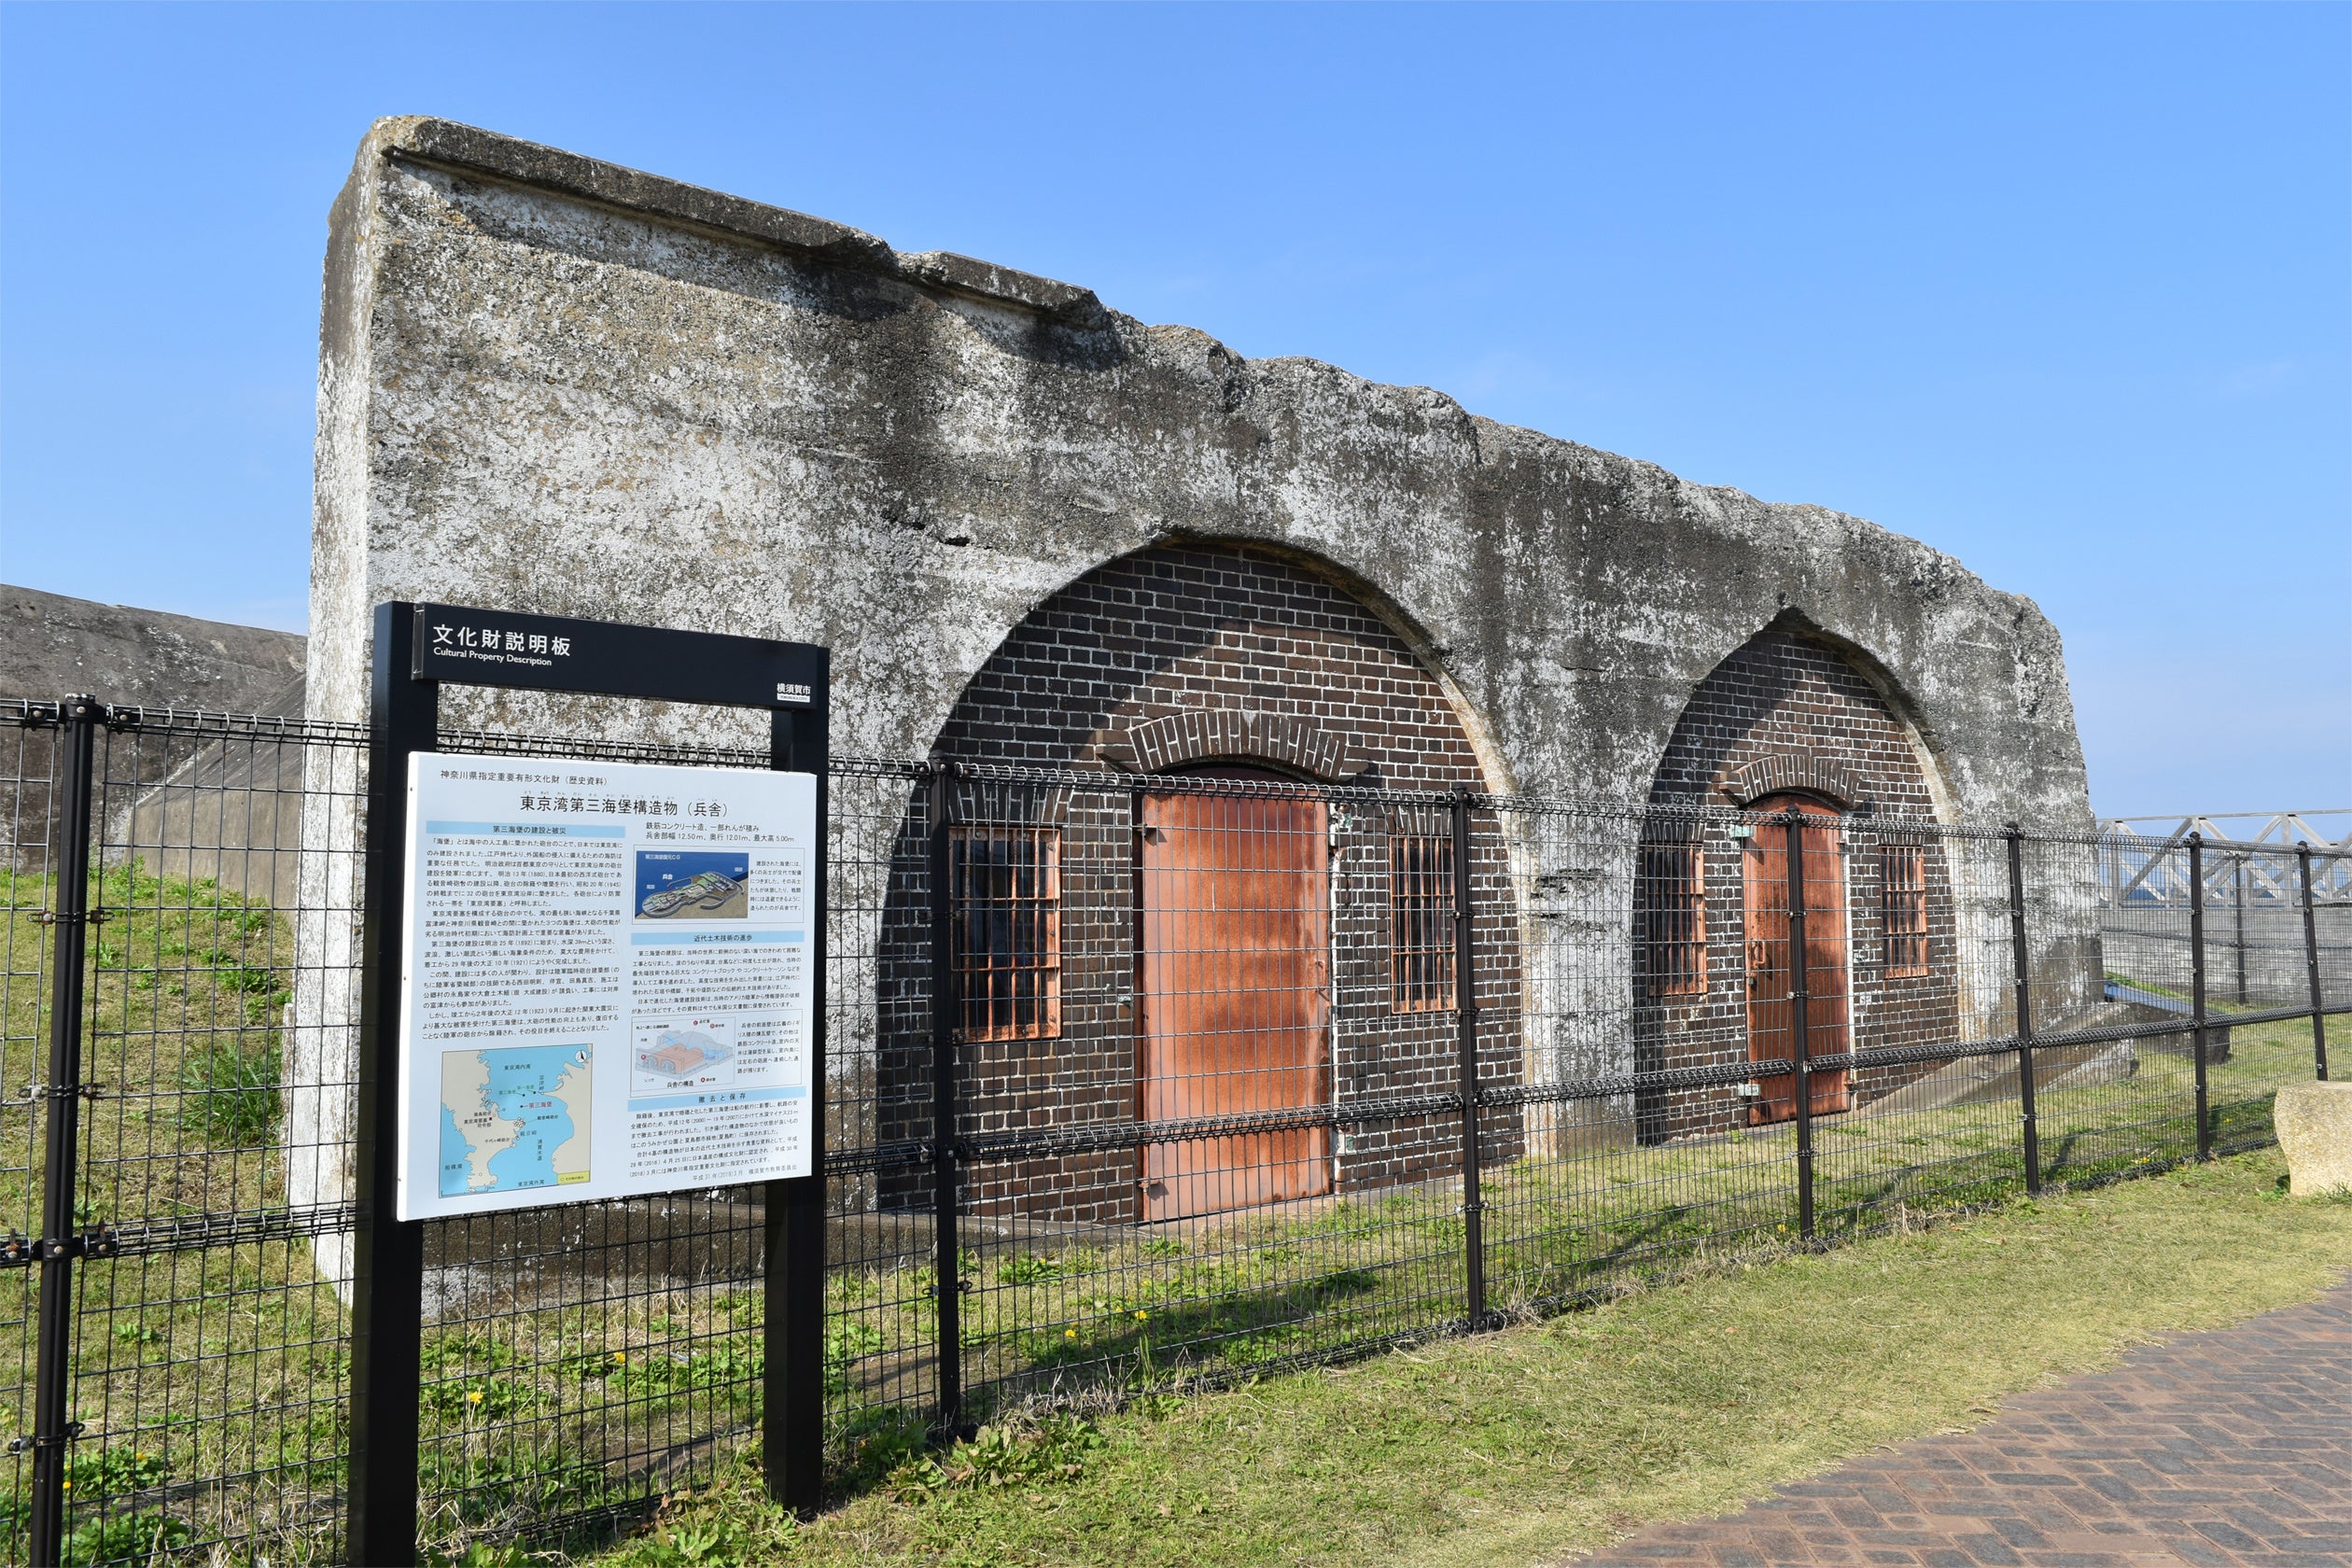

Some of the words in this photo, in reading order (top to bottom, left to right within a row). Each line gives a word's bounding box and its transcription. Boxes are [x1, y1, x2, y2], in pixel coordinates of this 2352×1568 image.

[432, 624, 571, 656] 文化財説明板
[433, 647, 468, 659] Cultural
[469, 651, 504, 664] Property
[507, 653, 552, 666] Description
[777, 683, 811, 695] 横須賀市
[493, 825, 567, 835] 第三海堡の建設と被災
[693, 934, 752, 943] 近代土木技術の進歩
